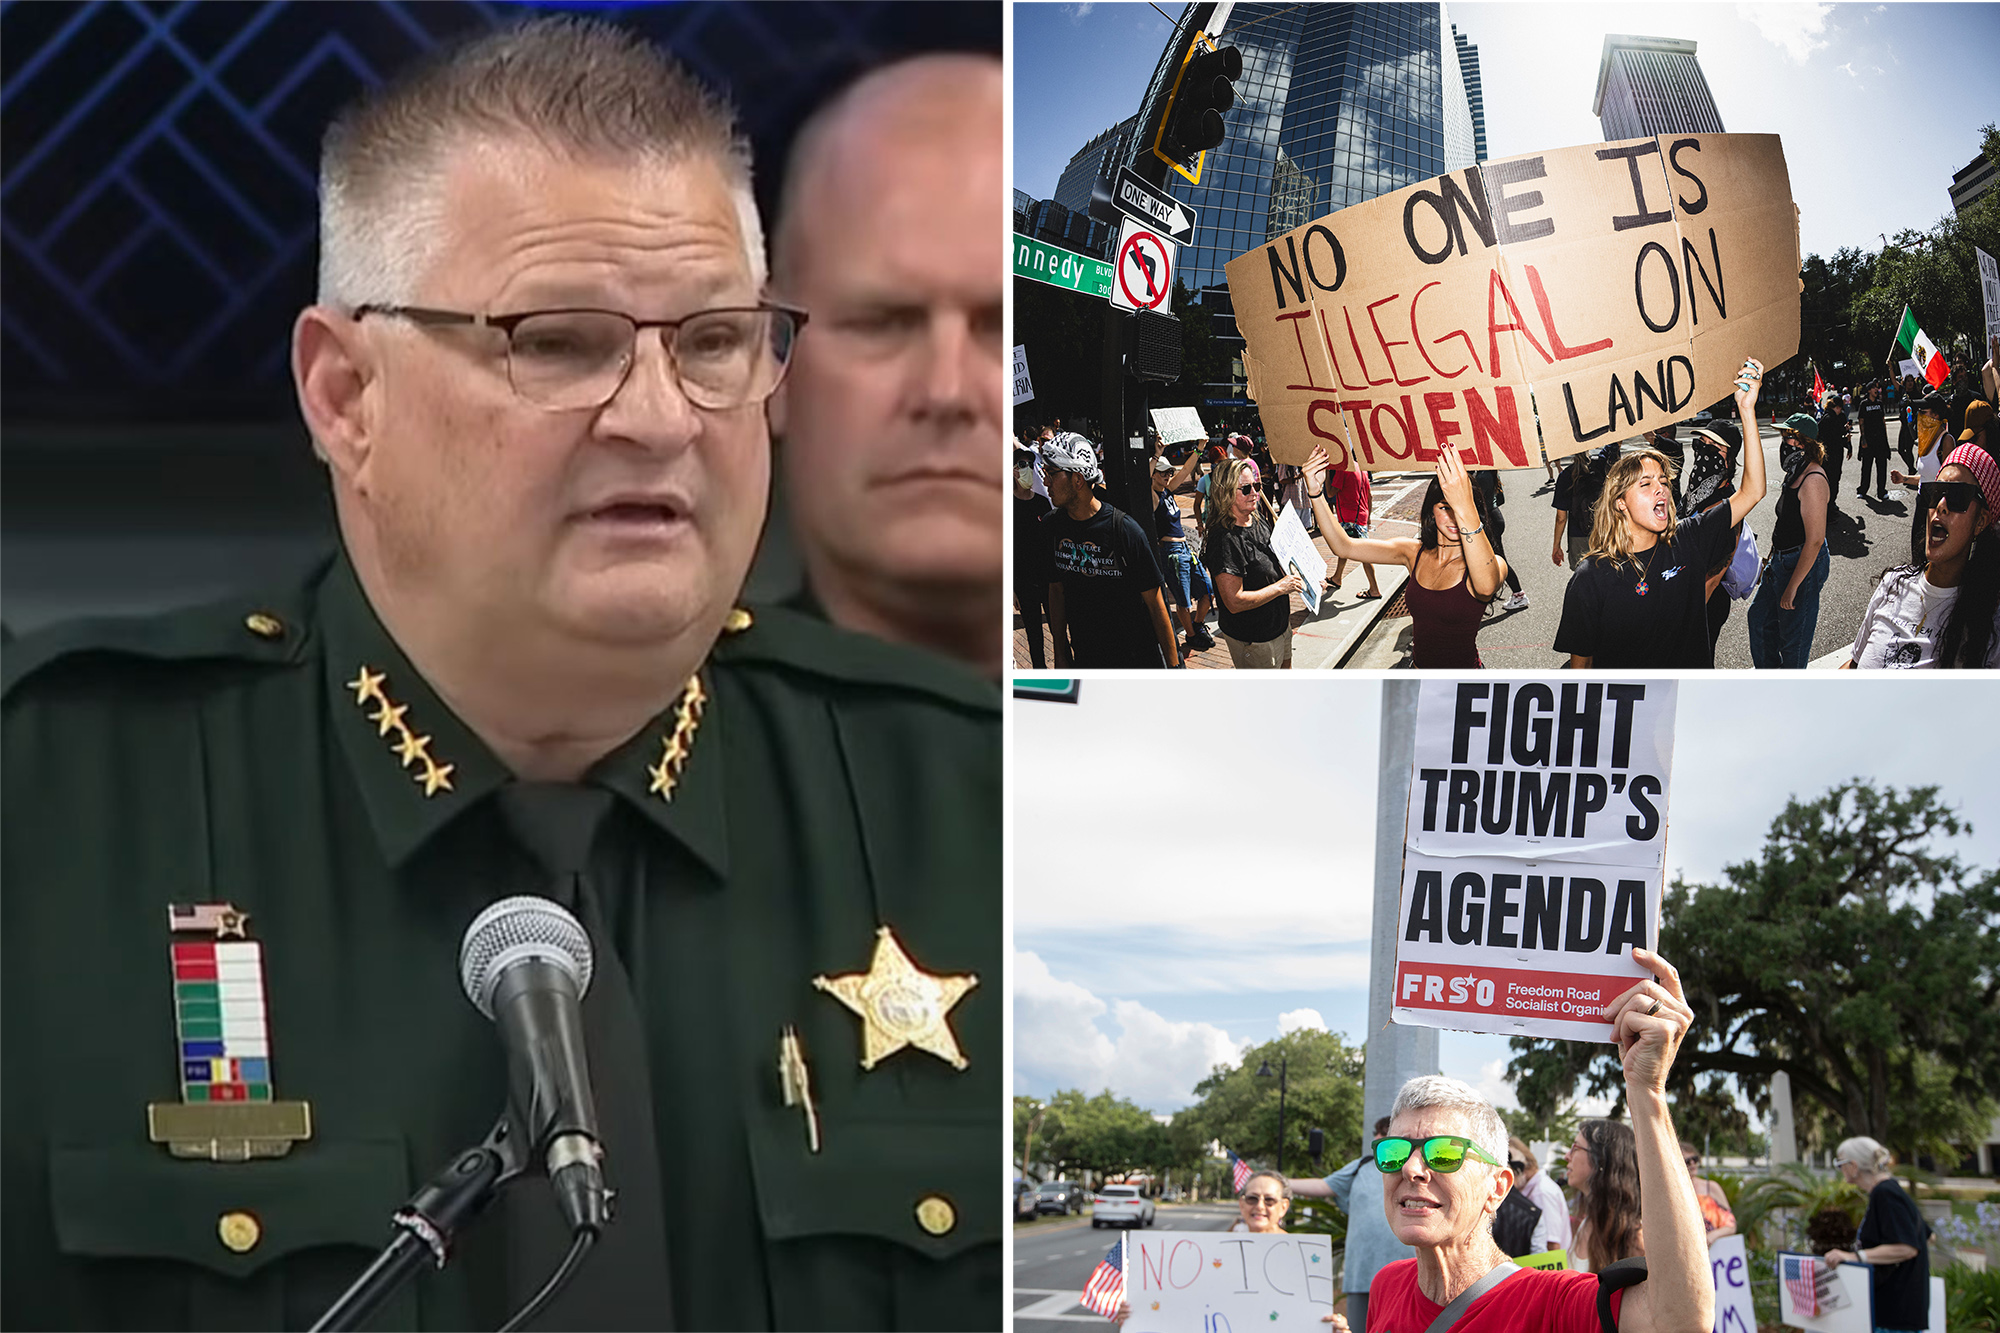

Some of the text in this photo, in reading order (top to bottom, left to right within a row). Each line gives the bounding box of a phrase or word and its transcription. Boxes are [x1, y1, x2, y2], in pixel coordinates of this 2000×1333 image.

[1125, 184, 1173, 222] ONE WAY
[1266, 138, 1708, 309] NO ONE IS
[1013, 241, 1085, 288] nnedy
[1095, 265, 1112, 278] BLVD
[1275, 227, 1727, 393] ILLEGAL ON
[1307, 355, 1695, 471] STOLEN LAND
[1062, 541, 1076, 549] WAR
[1082, 544, 1101, 553] PEACE
[1450, 682, 1646, 769] FIGHT
[1419, 768, 1662, 842] TRUMP'S
[1404, 870, 1647, 955] AGENDA
[1402, 973, 1496, 1007] FRSO
[1505, 997, 1606, 1017] Socialist Organi
[1507, 983, 1600, 1001] Freedom Road
[1141, 1239, 1333, 1306] NO ICE
